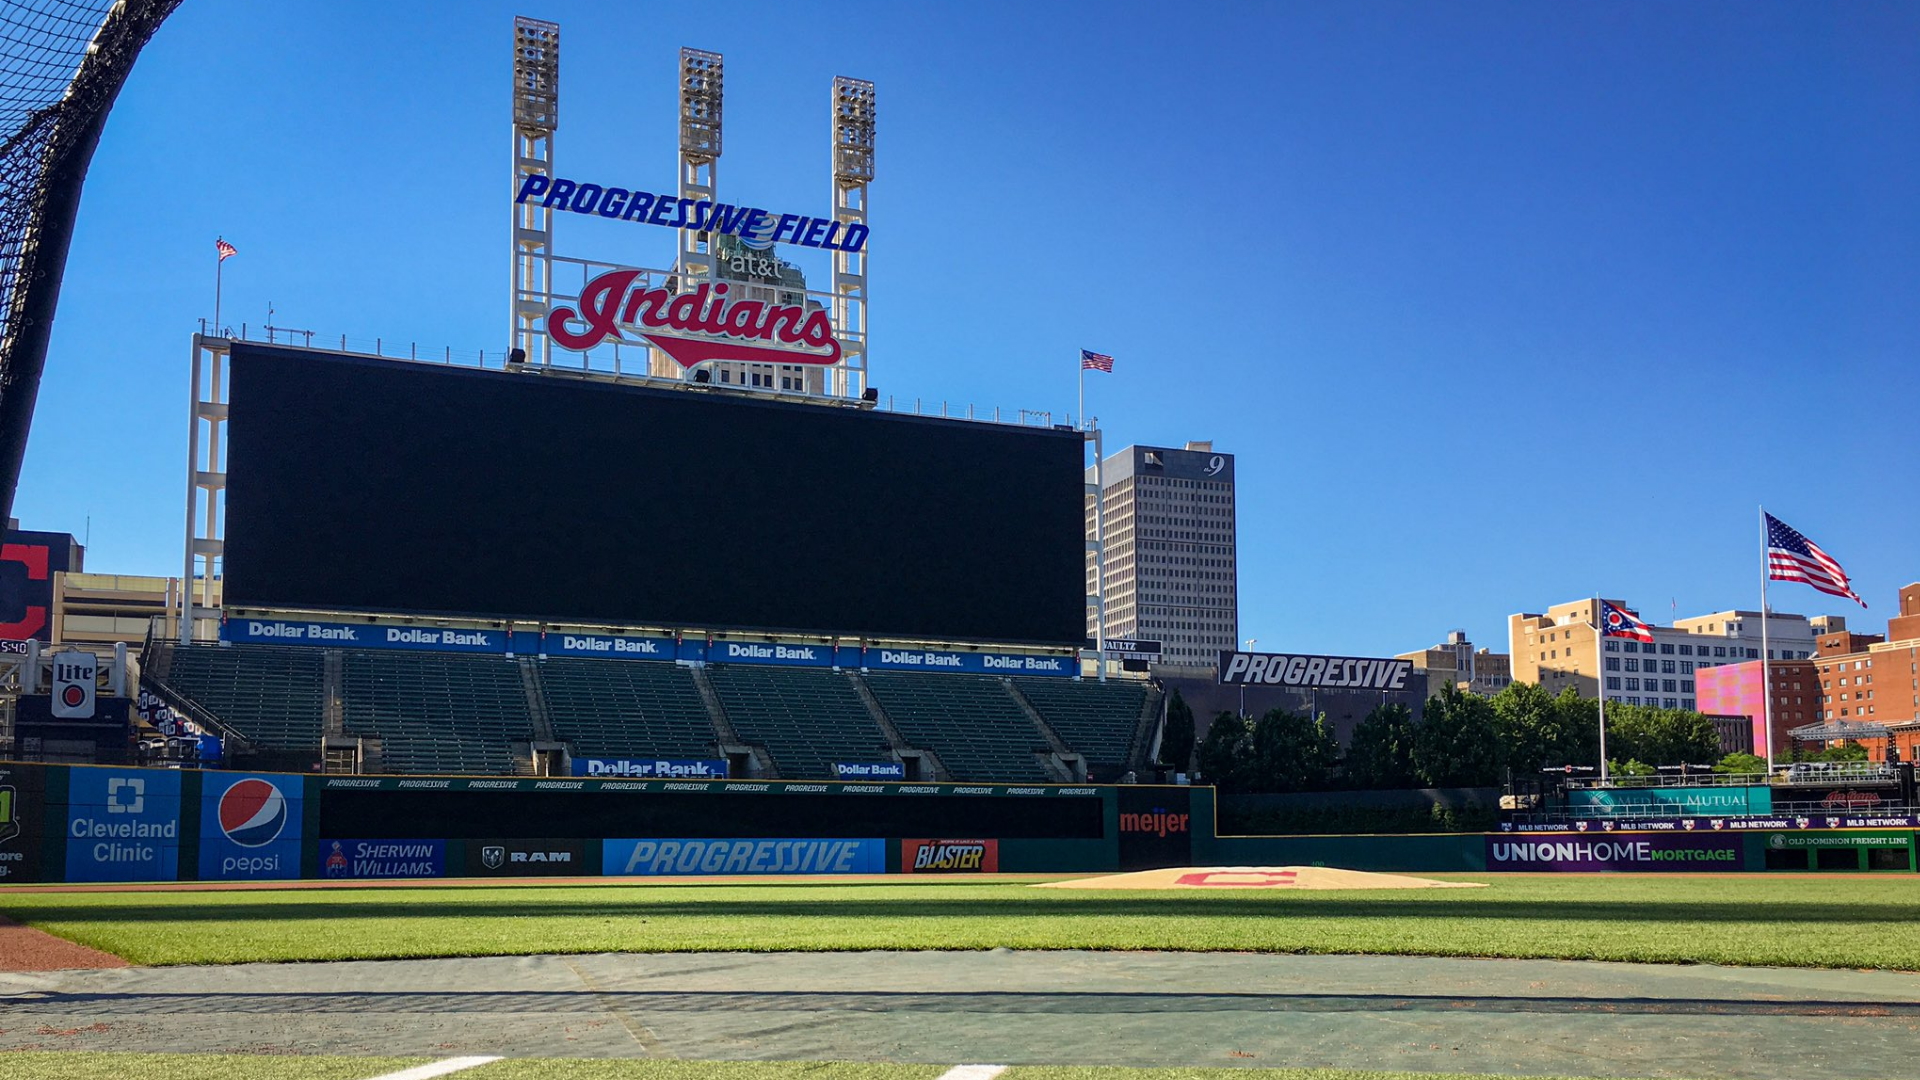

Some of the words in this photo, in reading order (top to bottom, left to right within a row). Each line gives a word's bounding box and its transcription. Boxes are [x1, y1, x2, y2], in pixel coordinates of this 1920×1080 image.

[516, 174, 768, 238] PROGRESSIVE
[771, 213, 870, 253] FIELD
[731, 253, 783, 279] at&t
[548, 268, 842, 358] Indians
[1208, 456, 1225, 477] 9
[249, 622, 304, 637] Dollar
[387, 628, 440, 643] Dollar
[1, 641, 27, 654] 5:40
[564, 636, 612, 650] Dollar
[729, 644, 773, 658] Dollar
[882, 651, 923, 664] Dollar
[984, 655, 1023, 668] Dollar
[57, 664, 93, 684] Lite
[1223, 654, 1411, 689] PROGRESSIVE
[588, 760, 652, 776] Dollar
[838, 764, 871, 774] Dollar
[327, 779, 381, 788] PROGRESSIVE
[398, 780, 451, 788] PROGRESSIVE
[468, 781, 519, 789] PROGRESSIVE
[535, 781, 585, 789] PROGRESSIVE
[600, 782, 648, 790] PROGRESSIVE
[663, 783, 709, 791] PROGRESSIVE
[785, 784, 828, 792] PROGRESSIVE
[842, 785, 885, 793] PROGRESSIVE
[899, 786, 940, 794] PROGRESSIVE
[953, 787, 993, 795] PROGRESSIVE
[1687, 795, 1747, 806] MUTUAL
[71, 818, 176, 838] Cleveland
[1120, 807, 1188, 837] meijer
[1637, 822, 1674, 830] NETWORK
[1730, 821, 1747, 829] MLB
[1748, 820, 1788, 828] NETWORK
[1846, 819, 1865, 827] MLB
[1866, 818, 1909, 827] NETWORK
[93, 843, 153, 862] Clinic
[355, 842, 433, 858] SHERWIN
[1651, 849, 1736, 861] MORTGAGE
[510, 852, 571, 862] RAM
[625, 841, 860, 873] PROGRESSIVE
[223, 854, 279, 875] pepsi
[353, 860, 433, 876] WILLIAMS
